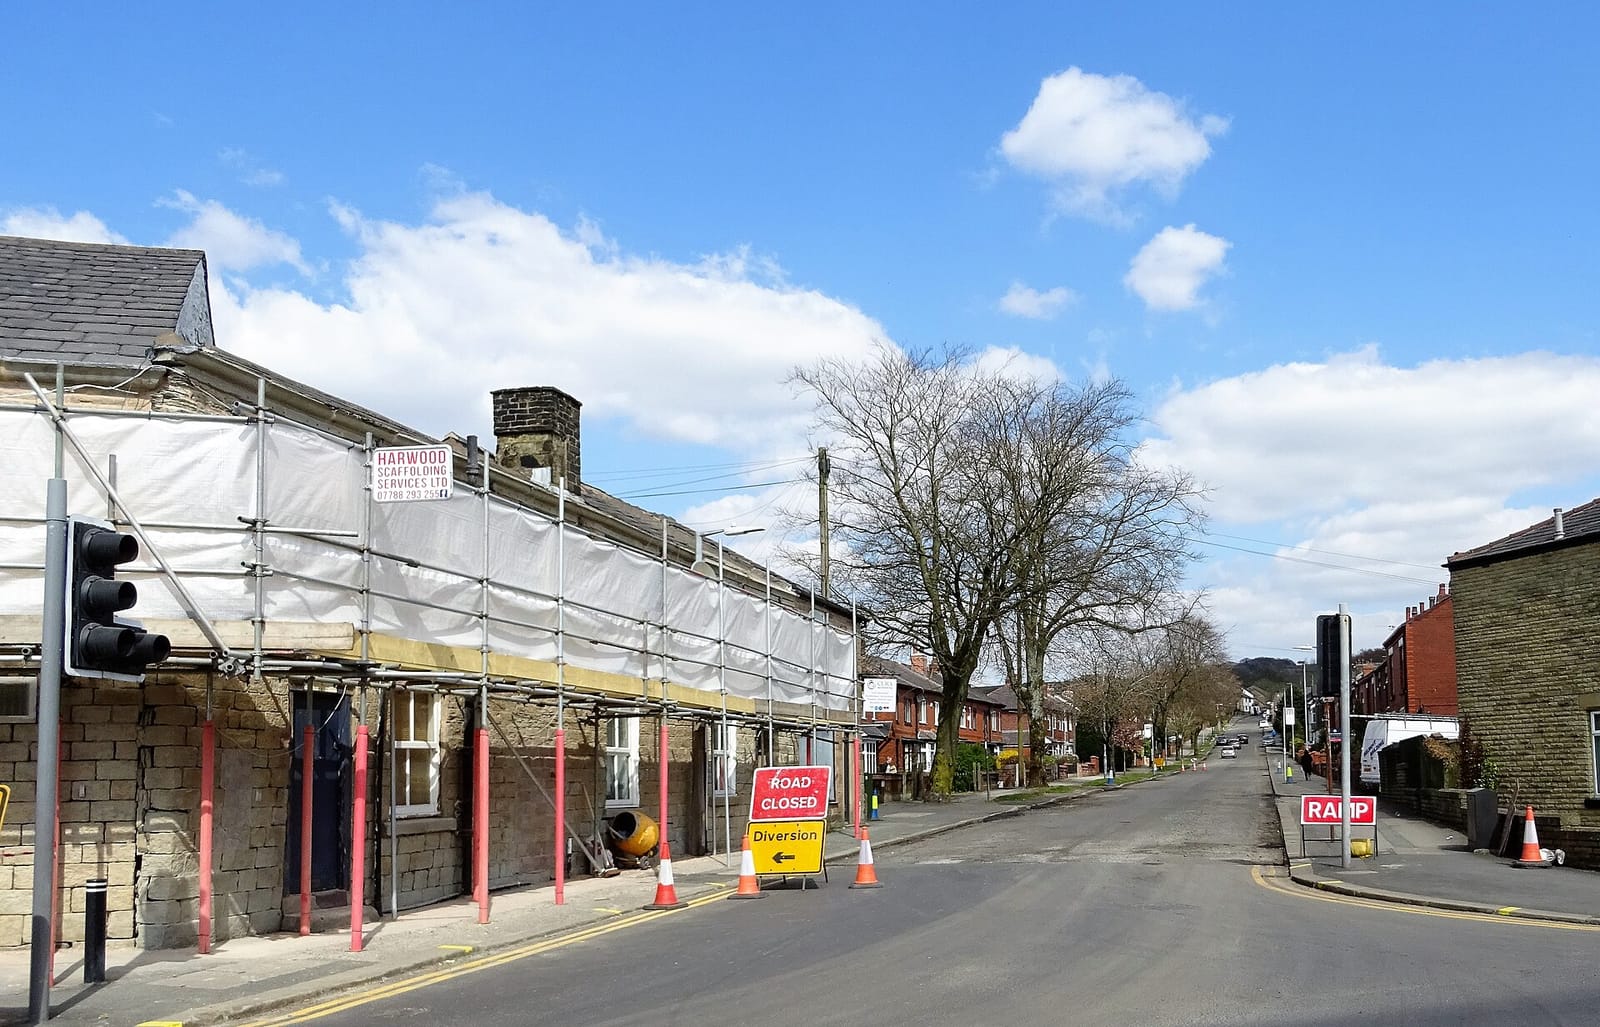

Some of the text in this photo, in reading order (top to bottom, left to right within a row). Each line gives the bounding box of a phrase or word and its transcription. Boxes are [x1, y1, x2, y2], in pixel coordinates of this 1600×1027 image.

[378, 450, 446, 465] HARWOOD
[378, 465, 447, 477] SCAFFOLDING
[378, 477, 448, 489] SERVICES LTD
[406, 490, 421, 499] 293
[770, 776, 812, 789] ROAD
[761, 796, 817, 810] CLOSED
[753, 830, 817, 842] Diversion
